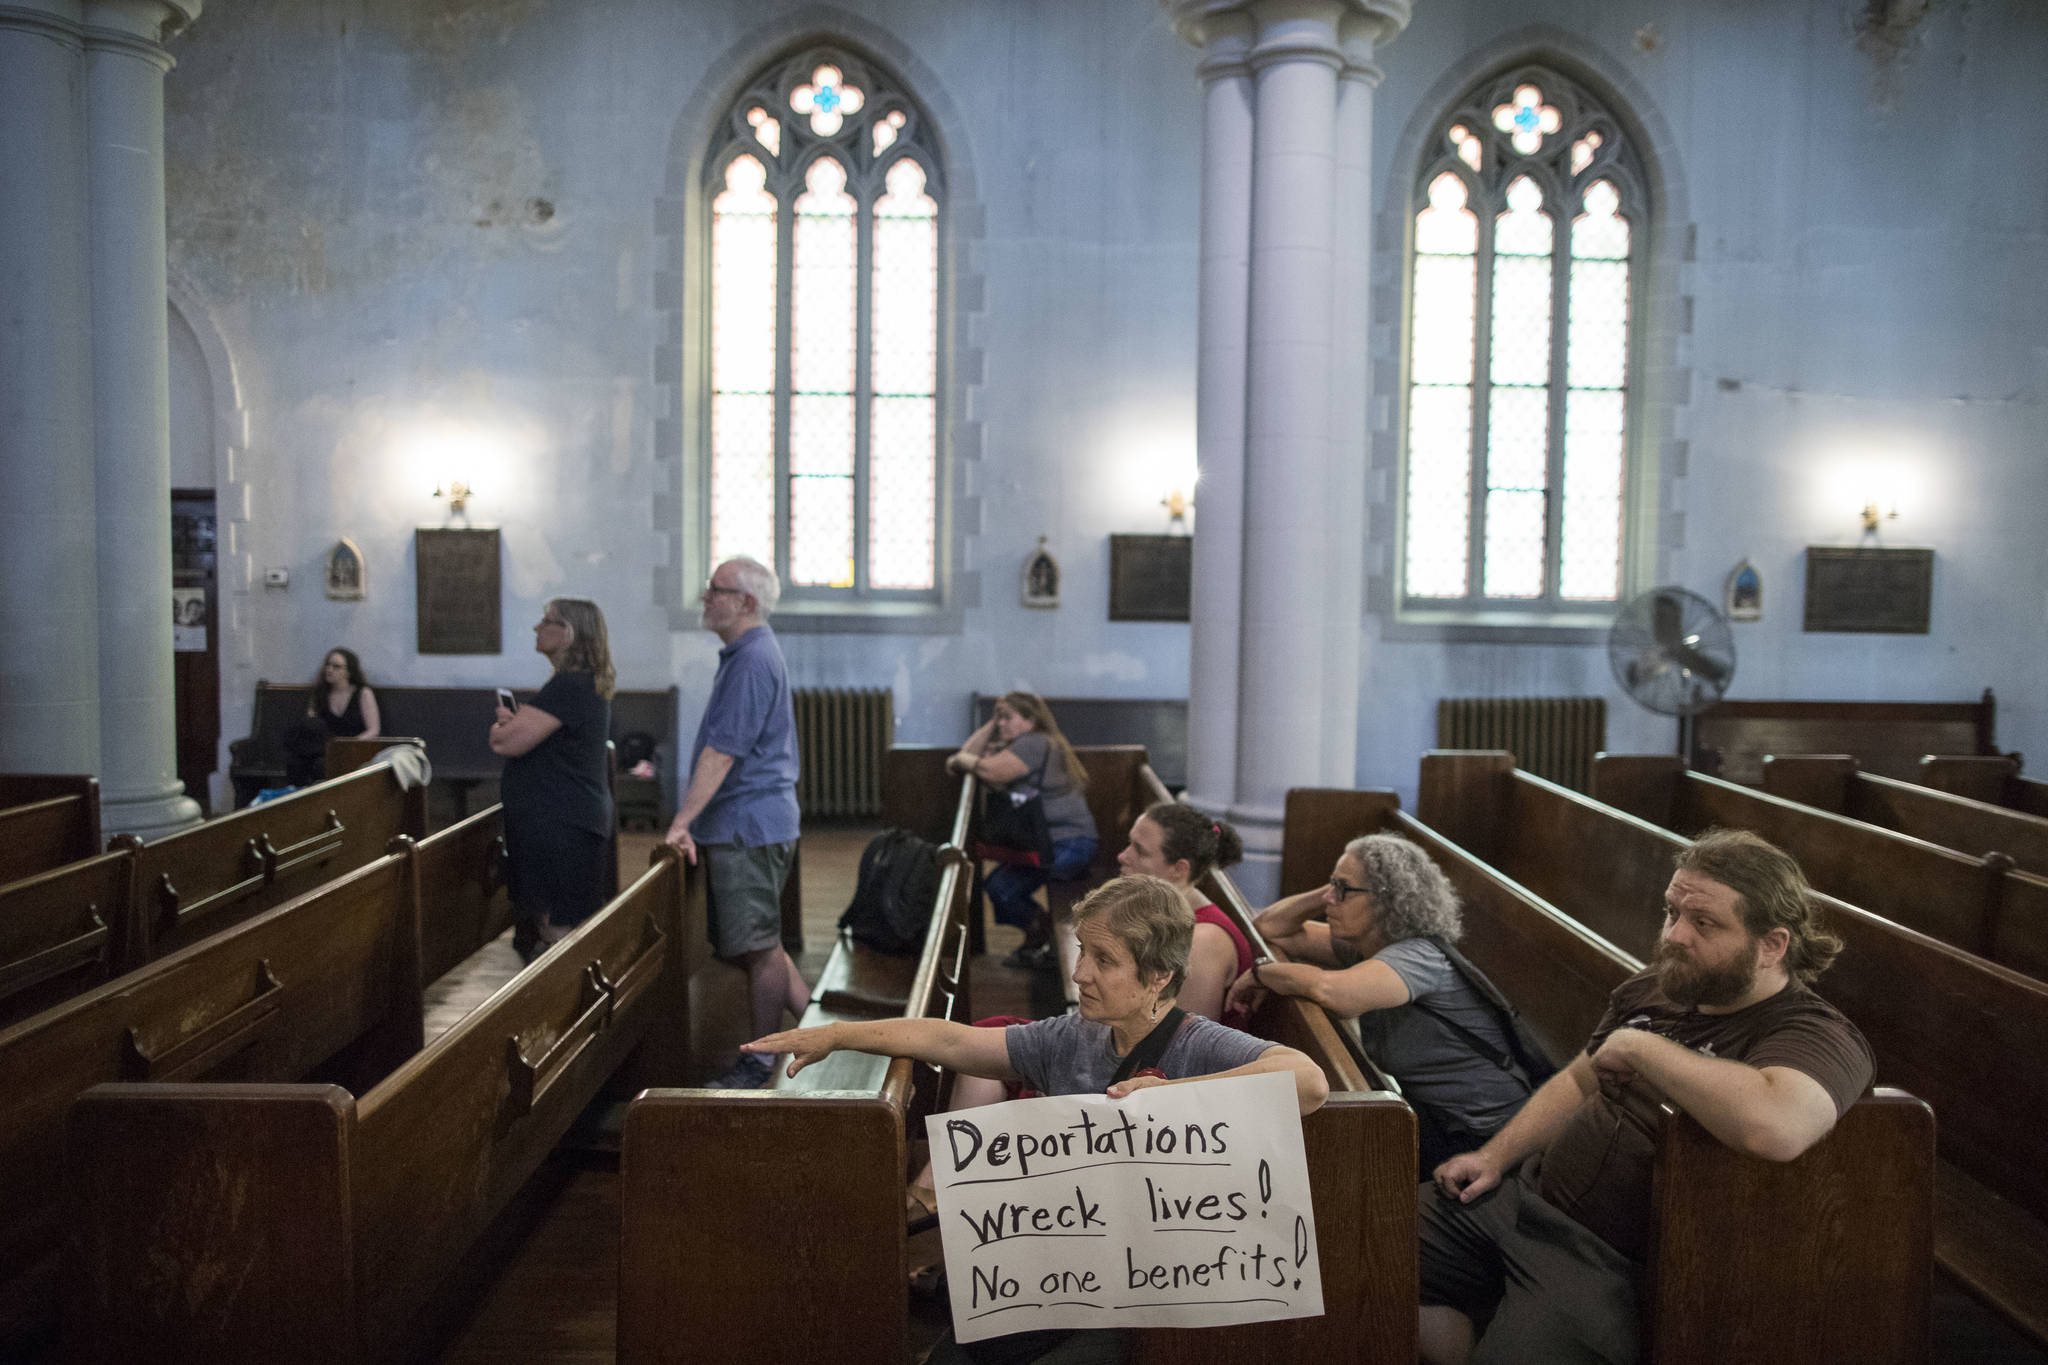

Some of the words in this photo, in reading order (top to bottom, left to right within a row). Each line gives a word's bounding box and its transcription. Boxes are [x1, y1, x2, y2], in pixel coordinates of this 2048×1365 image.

[947, 1109, 1230, 1175] Deportations
[1145, 1158, 1272, 1222] lives!
[972, 1264, 1020, 1309] No
[1040, 1270, 1102, 1294] one
[1126, 1215, 1308, 1290] benefits!
